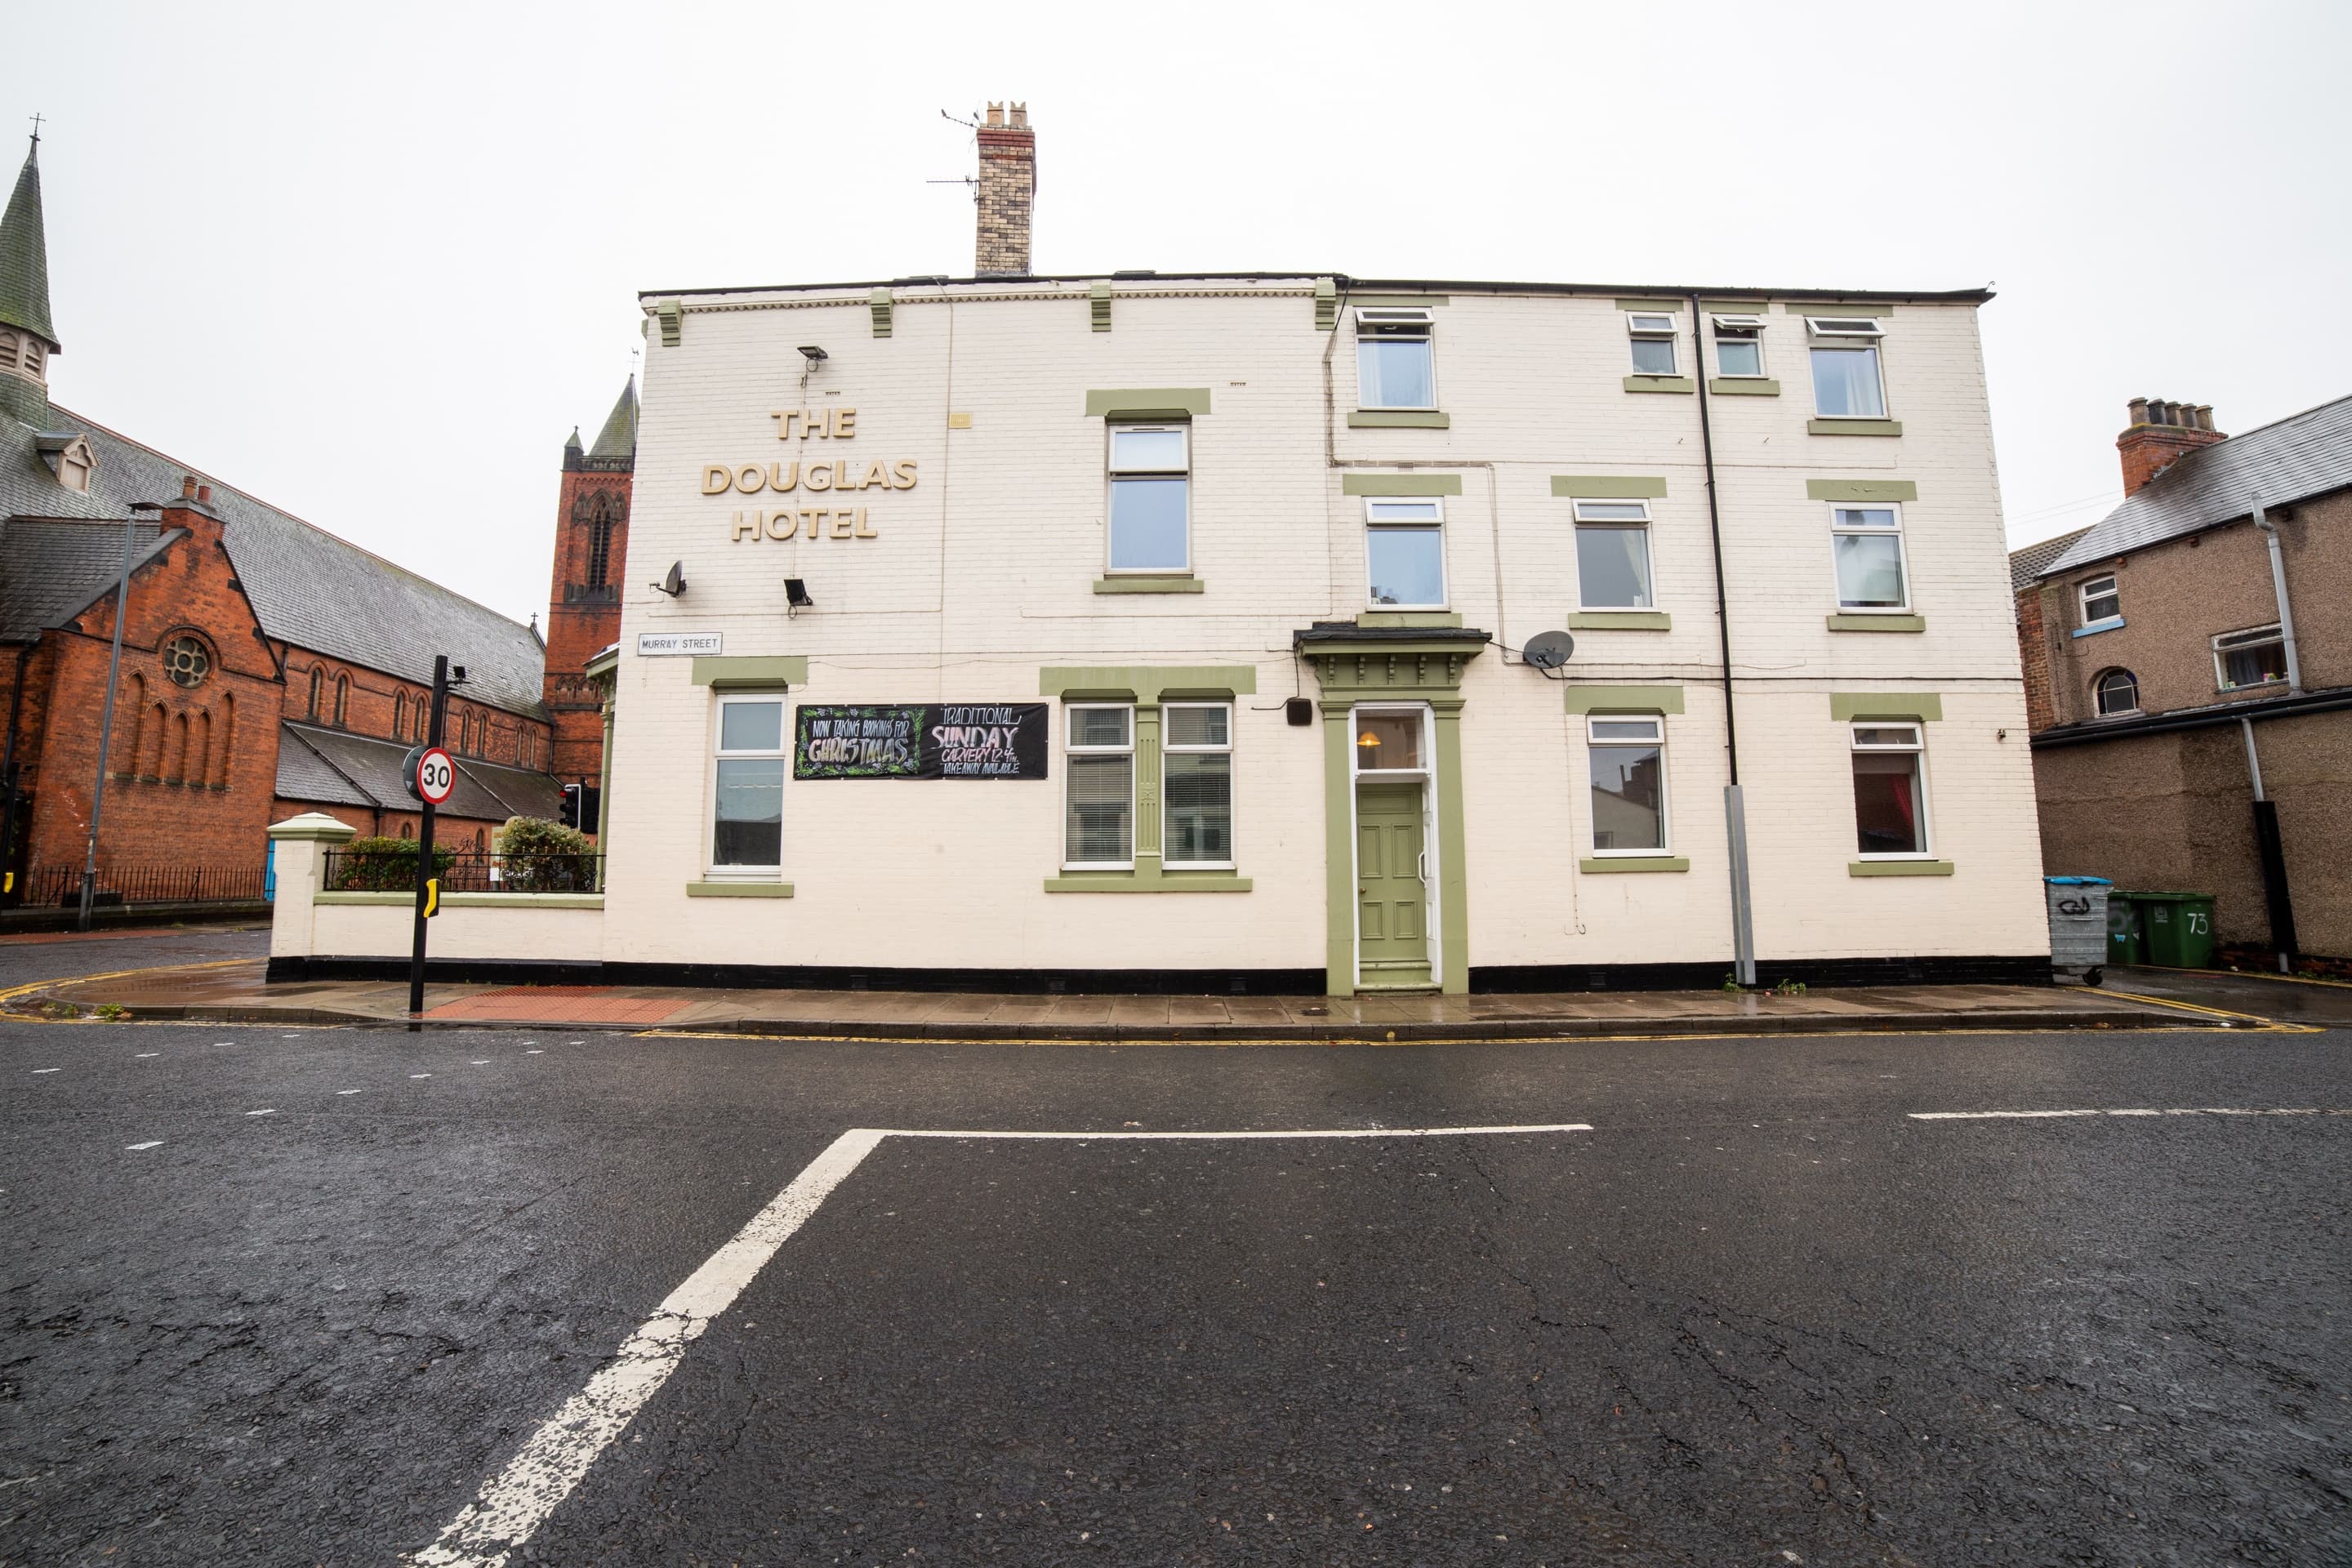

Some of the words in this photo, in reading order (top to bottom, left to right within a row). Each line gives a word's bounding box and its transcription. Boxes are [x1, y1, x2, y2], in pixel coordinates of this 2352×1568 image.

[770, 408, 857, 439] THE
[702, 458, 917, 495] DOUGLAS
[732, 506, 878, 541] HOTEL
[642, 639, 677, 649] MURRAY
[682, 639, 717, 648] STREET
[940, 706, 1022, 724] TRADITIONAL
[813, 719, 831, 737] NOW
[833, 719, 859, 737] TAKING
[862, 719, 894, 737] BOOKINGS
[893, 720, 910, 737] FOR
[930, 725, 1020, 749] SUNDAY
[808, 736, 909, 766] CHRISTMAS
[941, 747, 991, 763] CARVERY
[423, 763, 450, 788] 30
[981, 762, 1020, 774] AVAILABLE
[2187, 912, 2208, 934] 73
